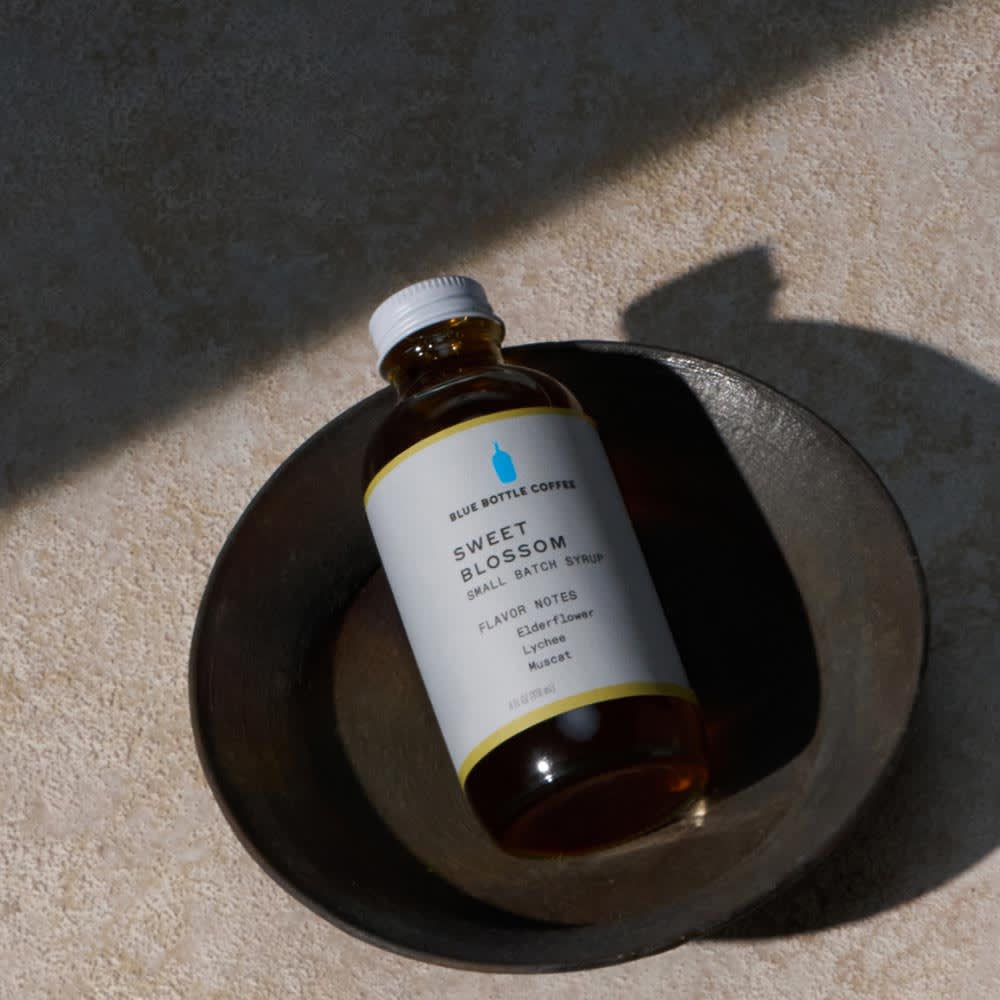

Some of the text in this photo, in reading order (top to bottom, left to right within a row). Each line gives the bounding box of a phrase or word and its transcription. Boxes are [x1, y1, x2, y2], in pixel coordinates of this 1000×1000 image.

[449, 479, 577, 522] BLUE BOTTLE COFFEE
[452, 520, 528, 562] SWEET
[460, 535, 568, 583] BLOSSOM
[466, 552, 605, 601] SMALL BATCH SYRUP
[477, 589, 579, 634] FLAVOR NOTES
[516, 608, 595, 638] Elderflower
[522, 634, 567, 656] Lychee
[528, 650, 573, 673] Muscat
